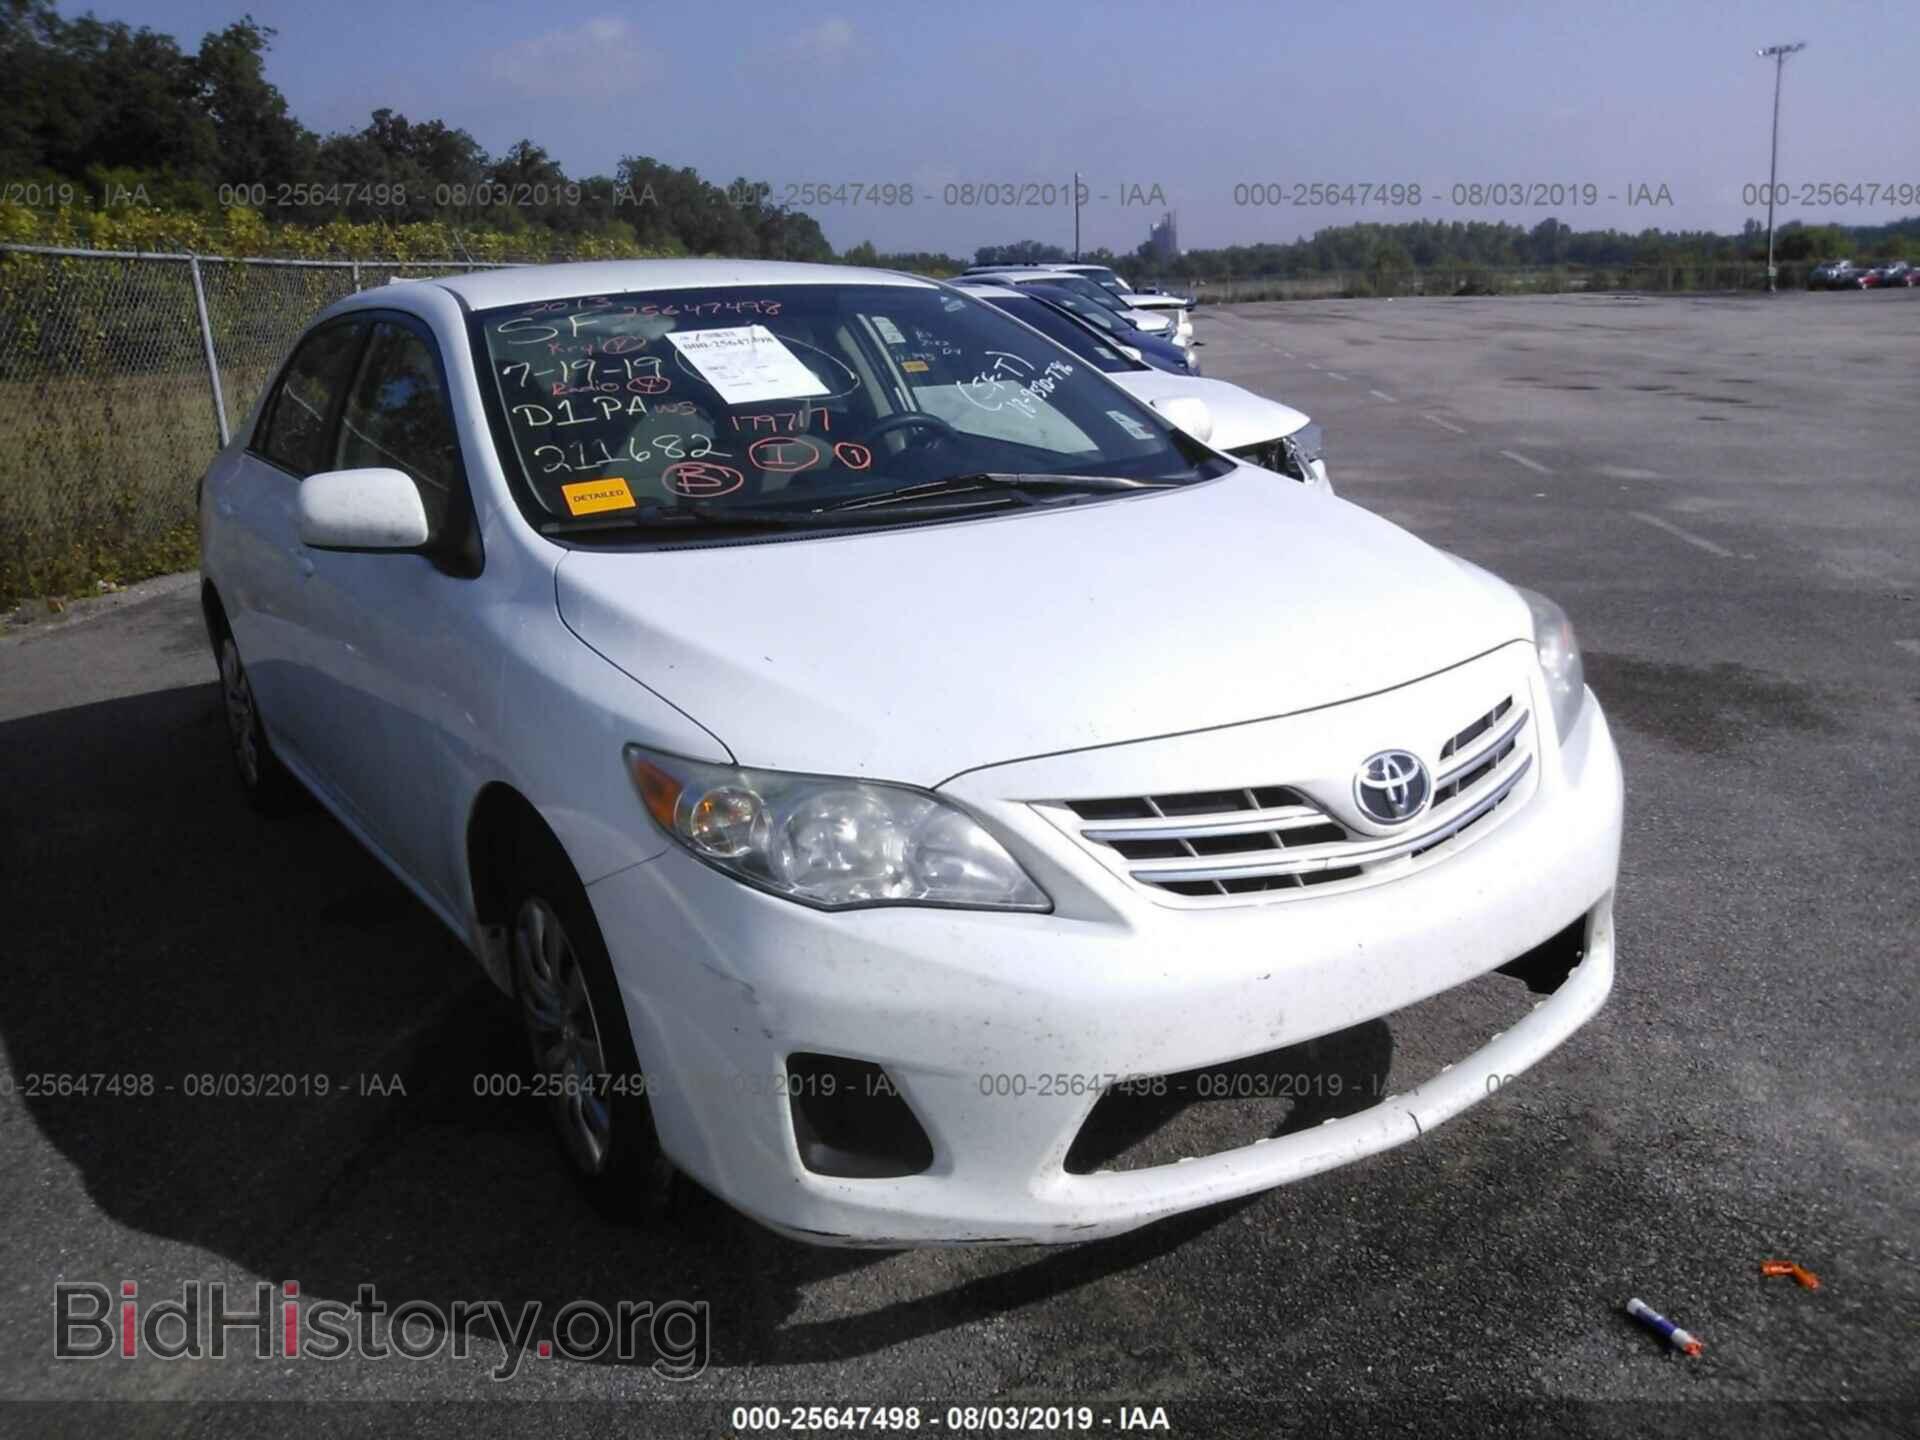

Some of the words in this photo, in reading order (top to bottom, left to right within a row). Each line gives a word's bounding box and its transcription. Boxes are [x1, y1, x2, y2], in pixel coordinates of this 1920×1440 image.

[503, 357, 662, 387] 7-19-19
[534, 433, 734, 472] 211682
[573, 489, 625, 503] DETAILED
